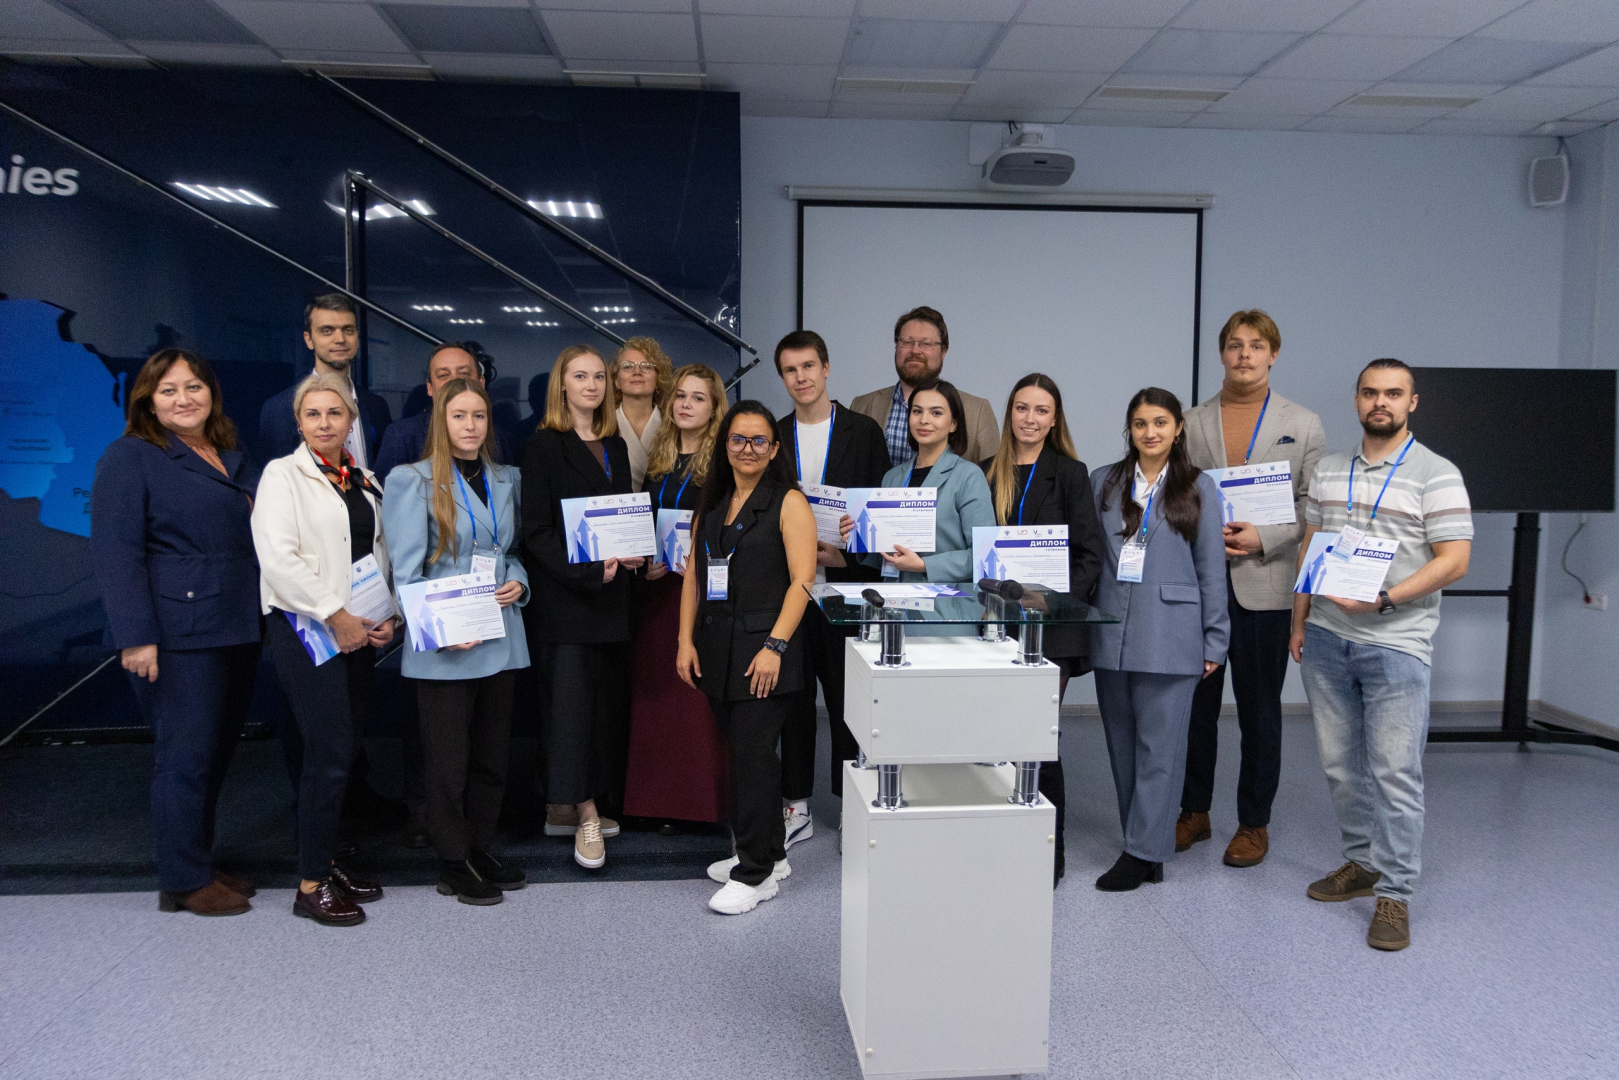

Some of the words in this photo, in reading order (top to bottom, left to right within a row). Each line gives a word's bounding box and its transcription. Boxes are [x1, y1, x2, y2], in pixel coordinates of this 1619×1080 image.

[0, 154, 79, 196] ies
[1254, 474, 1289, 485] ДИПЛОМ
[818, 498, 847, 508] ДИПЛО
[617, 505, 650, 515] ДИПЛОМ
[1030, 540, 1067, 548] ДИПЛОМ
[1355, 549, 1392, 560] ДИПЛОМ
[461, 585, 496, 597] ДИПЛОМ
